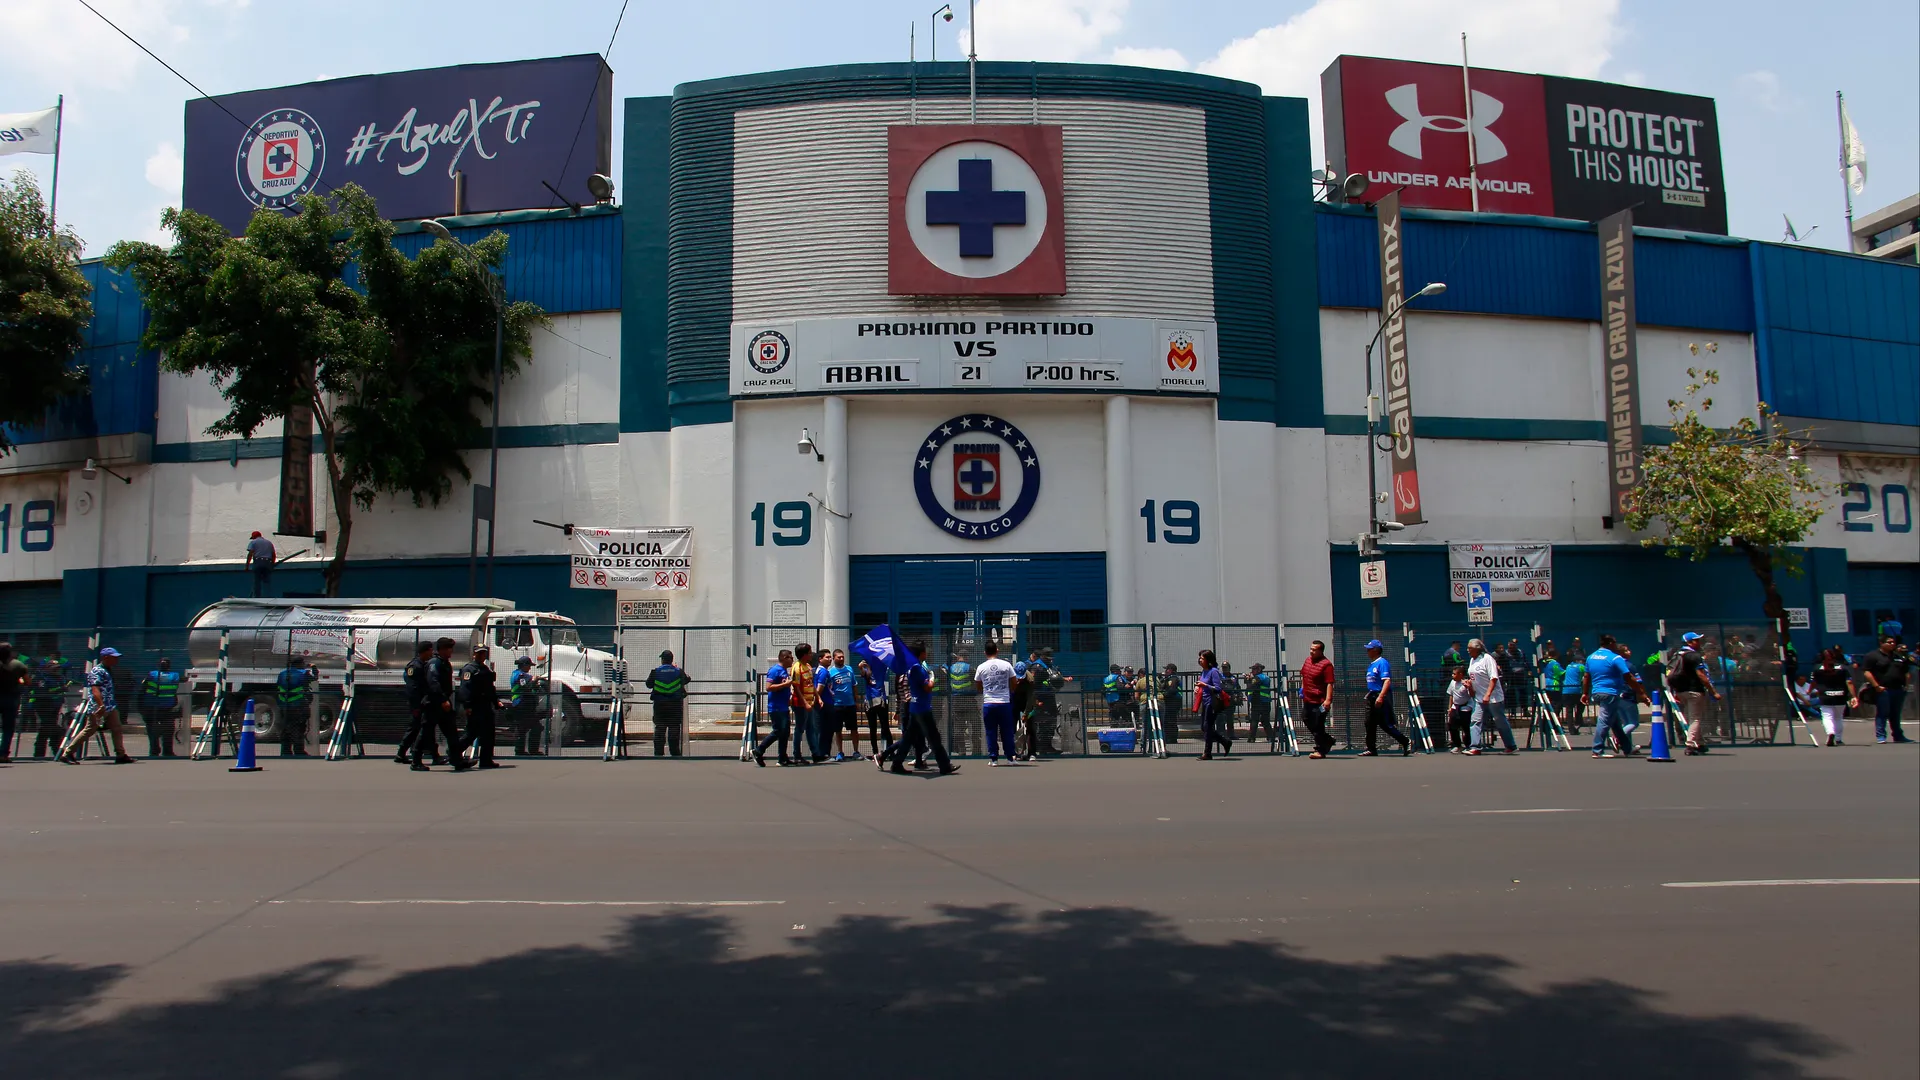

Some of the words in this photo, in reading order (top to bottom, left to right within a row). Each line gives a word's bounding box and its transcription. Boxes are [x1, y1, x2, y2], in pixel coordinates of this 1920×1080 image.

[264, 129, 299, 140] DEPORTIVO
[345, 96, 541, 180] #AzulXTi
[1568, 147, 1622, 183] THIS
[262, 180, 279, 189] CRUZ
[279, 178, 297, 187] AZUL
[1368, 170, 1439, 187] UNDER
[858, 321, 976, 337] PROXIMO
[985, 321, 1094, 336] PARTIDO
[1383, 214, 1411, 460] caliente.mx
[1608, 296, 1627, 362] CRUZ
[953, 341, 997, 357] VS
[825, 365, 910, 383] ABRIL
[961, 366, 982, 380] 21
[1026, 365, 1073, 380] 17:00
[1080, 366, 1120, 381] hrs.
[743, 379, 767, 387] CRUZ
[1161, 378, 1205, 386] MORELIA
[1611, 363, 1634, 486] CEMENTO
[953, 443, 1001, 454] DEPORTIVO
[953, 500, 977, 511] CRUZ
[979, 500, 1001, 511] AZUL
[1841, 482, 1913, 534] 20
[0, 500, 55, 554] 18
[751, 500, 812, 547] 19
[943, 517, 1012, 536] MEXICO
[1140, 499, 1201, 545] 19
[599, 542, 663, 555] POLICIA
[574, 557, 612, 567] PUNTO
[616, 558, 631, 567] DE
[635, 557, 691, 567] CONTROL
[1474, 556, 1530, 568] POLICIA
[1367, 568, 1378, 583] E
[1452, 570, 1487, 579] ENTRADA
[1488, 571, 1515, 579] PORRA
[1516, 570, 1550, 579] VISITANTE
